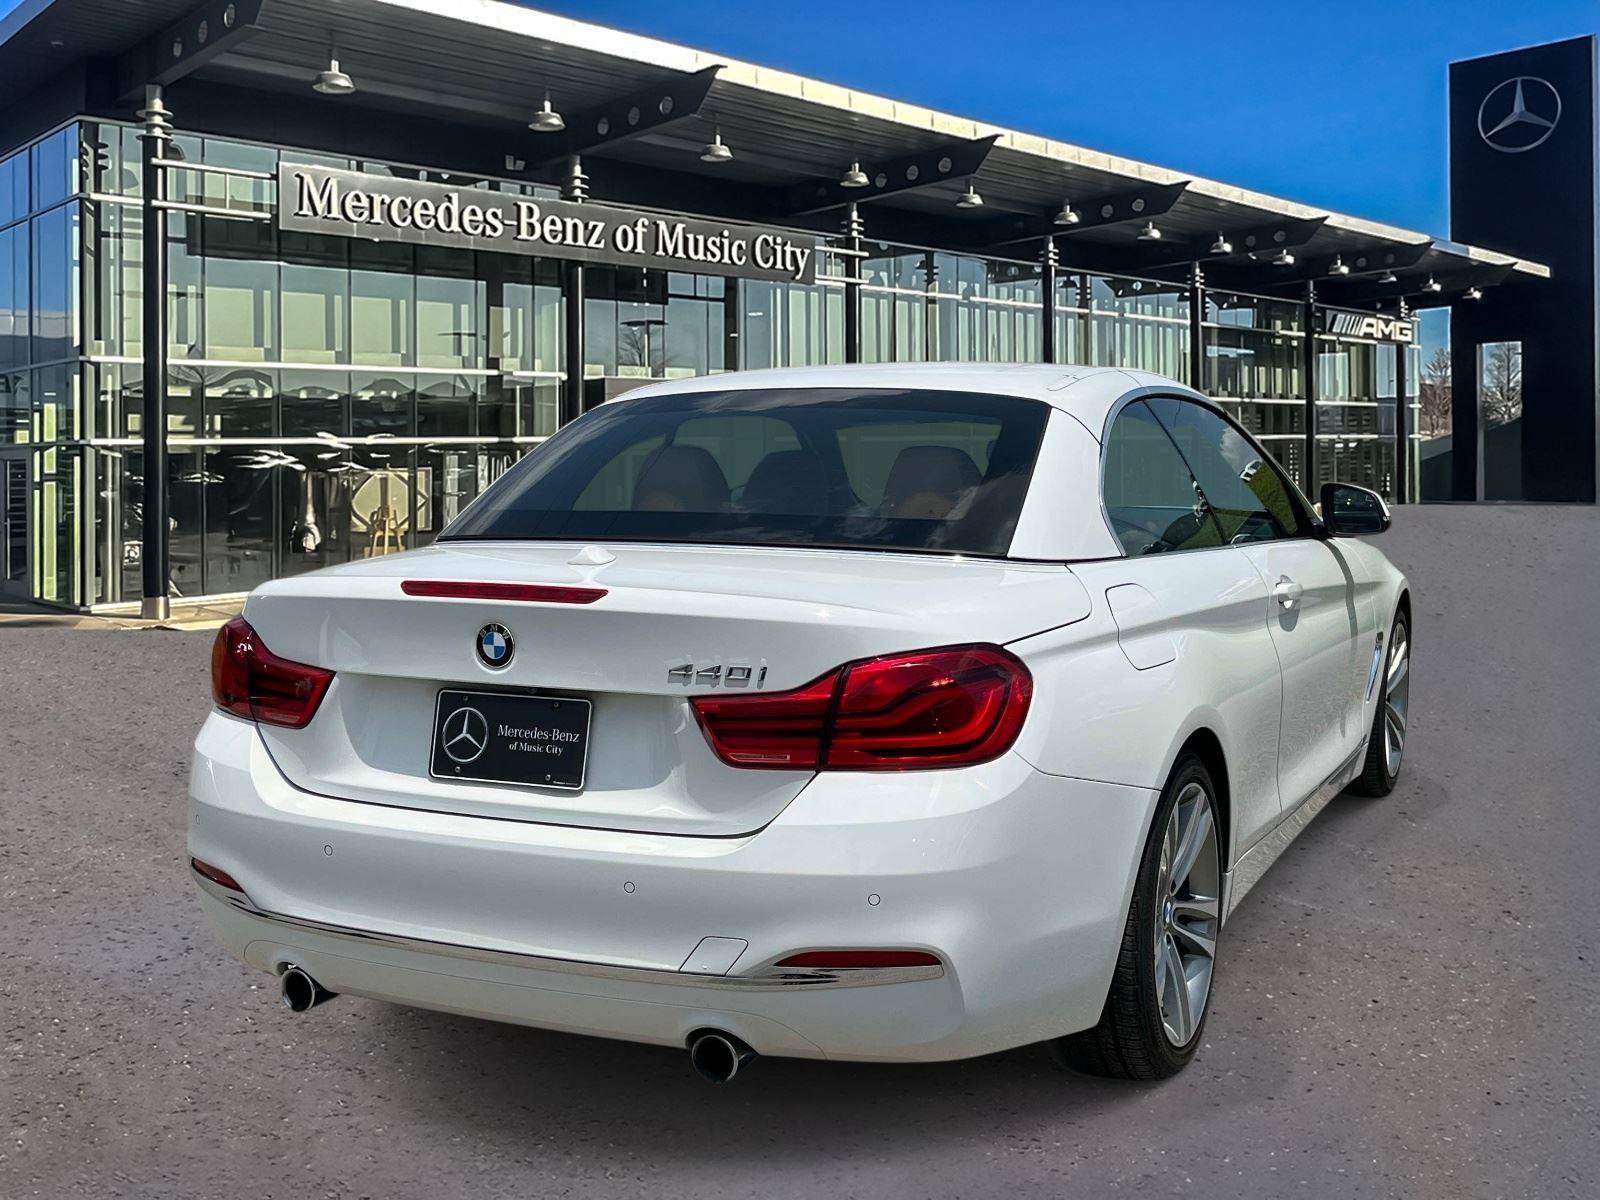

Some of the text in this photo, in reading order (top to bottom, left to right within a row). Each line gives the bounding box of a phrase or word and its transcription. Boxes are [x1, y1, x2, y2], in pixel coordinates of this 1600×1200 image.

[295, 172, 811, 280] Mercedes-Benz of Music City
[479, 623, 511, 640] BMW
[667, 659, 768, 684] 440i
[497, 724, 580, 743] Mercedes-Benz
[508, 741, 564, 756] of Music City
